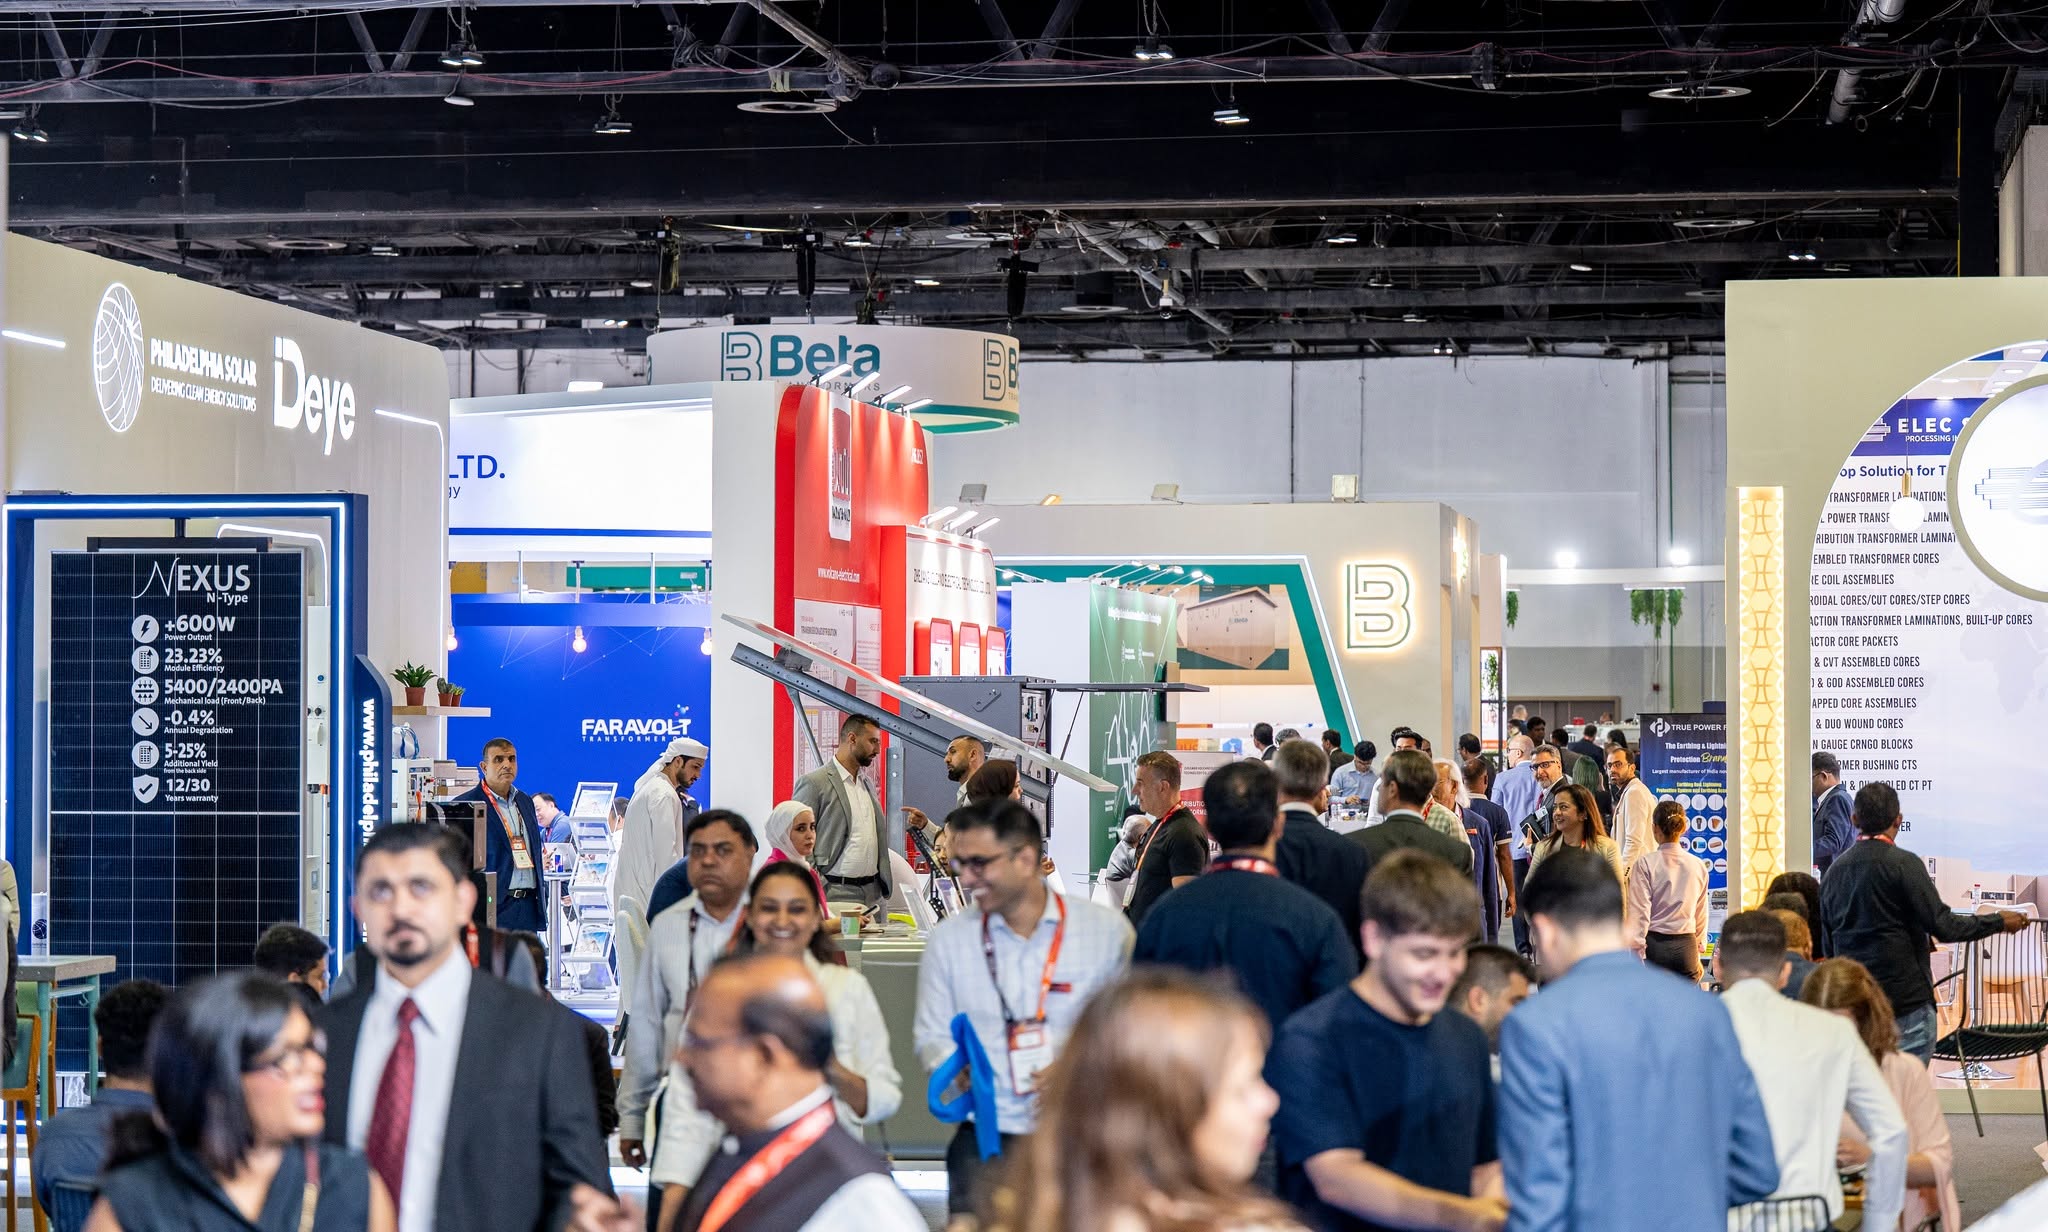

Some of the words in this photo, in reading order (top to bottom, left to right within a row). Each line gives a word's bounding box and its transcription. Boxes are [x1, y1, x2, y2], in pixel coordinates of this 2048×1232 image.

[770, 334, 880, 377] Beta
[150, 338, 224, 380] PHILADELPHIA
[224, 354, 257, 387] SOLAR
[150, 376, 185, 397] DELIVERING
[185, 383, 204, 402] CLEAN
[204, 388, 227, 406] ENERGY
[226, 392, 257, 412] SOLUTIONS
[274, 336, 356, 456] Deye
[1898, 417, 1952, 433] ELEC
[1916, 464, 1936, 476] for
[1827, 512, 1857, 524] POWER
[1857, 532, 1918, 544] TRANSFORMER
[1813, 554, 1847, 564] EMBLED
[1849, 553, 1911, 564] TRANSFORMER
[1913, 553, 1940, 564] CORES
[131, 557, 250, 598] NEXUS
[1821, 574, 1841, 585] COIL
[1842, 574, 1895, 585] ASSEMBLIES
[1840, 594, 1888, 606] CORES/CUT
[1890, 594, 1941, 605] CORES/STEP
[1943, 594, 1970, 605] CORES
[164, 614, 236, 632] +600W
[1840, 615, 1902, 626] TRANSFORMER
[1904, 614, 1964, 628] LAMINATIONS,
[1966, 614, 2004, 626] BUILT-UP
[2006, 614, 2033, 625] CORES
[187, 634, 212, 642] Output
[1838, 636, 1860, 647] CORE
[1862, 636, 1899, 647] PACKETS
[164, 648, 222, 664] 23.23%
[1814, 656, 1820, 668] &
[1823, 656, 1839, 668] CVT
[1841, 656, 1891, 668] ASSEMBLED
[1893, 656, 1920, 667] CORES
[192, 664, 224, 674] Efficiency
[164, 678, 284, 698] 5400/2400PA
[1817, 678, 1824, 688] &
[1846, 676, 1895, 688] ASSEMBLED
[1897, 676, 1924, 688] CORES
[164, 697, 202, 705] Mechanical
[204, 696, 220, 705] load
[221, 696, 266, 706] (Front/Back)
[1840, 698, 1863, 708] CORE
[1864, 697, 1917, 708] ASSEMBLIES
[164, 709, 215, 726] -0.4%
[1815, 718, 1822, 729] &
[1824, 718, 1842, 729] DUO
[1844, 718, 1874, 728] WOUND
[1876, 718, 1904, 728] CORES
[190, 726, 234, 736] Degradation
[581, 718, 692, 736] FARAVOLT
[1820, 738, 1848, 750] GAUGE
[1850, 738, 1878, 750] CRNGO
[1880, 738, 1914, 750] BLOCKS
[164, 742, 206, 759] 5-25%
[164, 760, 200, 768] Additional
[200, 760, 218, 768] Yield
[1862, 760, 1899, 770] BUSHING
[1901, 759, 1918, 770] CTS
[166, 778, 210, 792] 12/30
[1849, 780, 1856, 790] &
[1908, 780, 1920, 790] CT
[1922, 780, 1932, 790] PT
[186, 794, 218, 803] warranty
